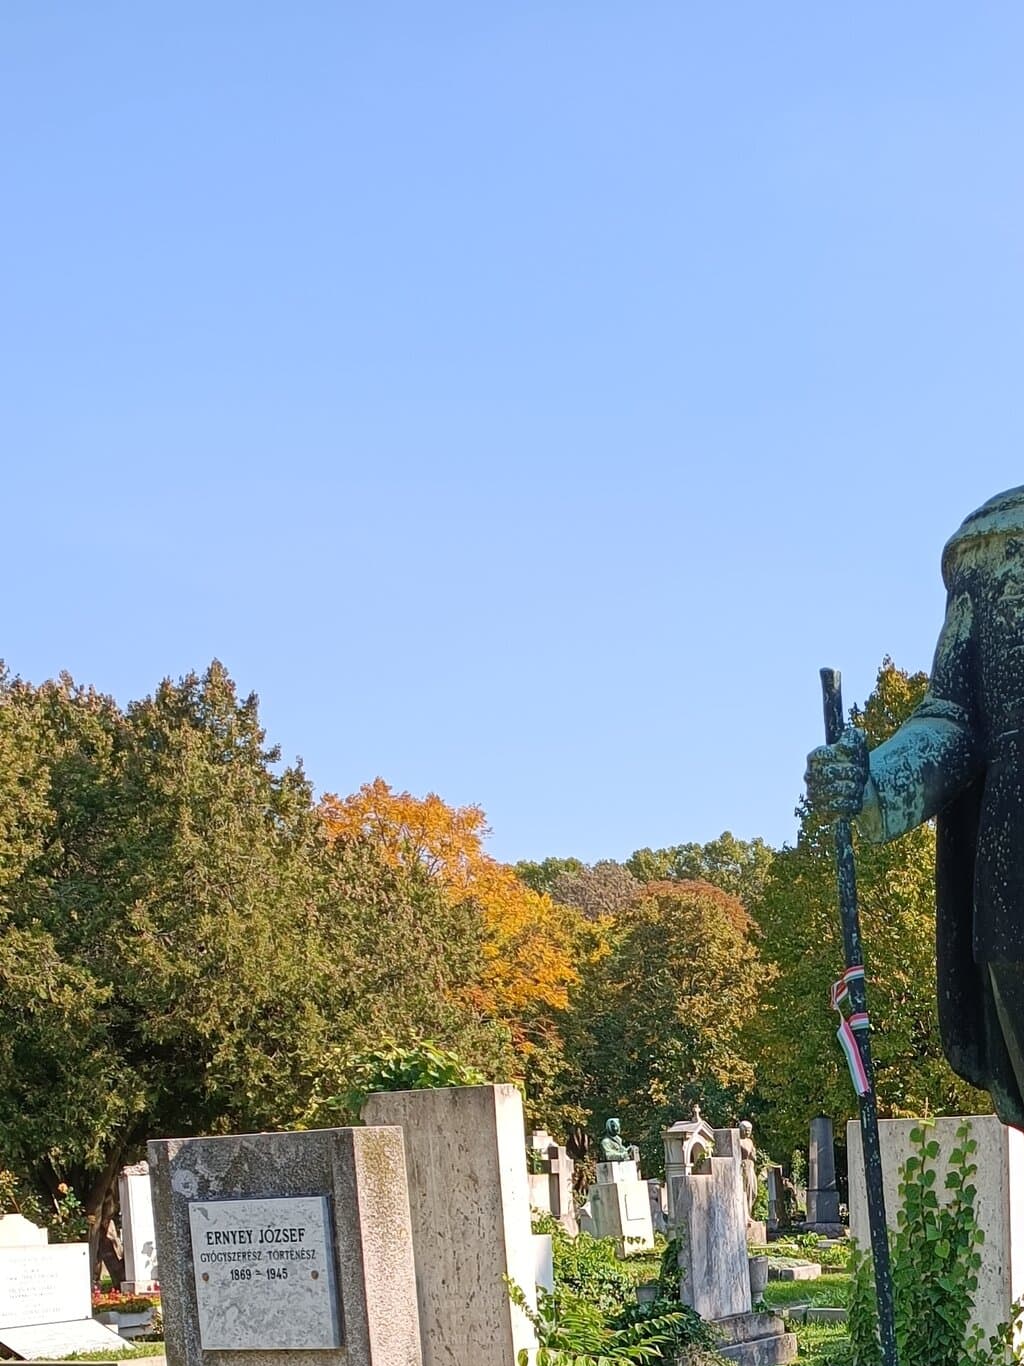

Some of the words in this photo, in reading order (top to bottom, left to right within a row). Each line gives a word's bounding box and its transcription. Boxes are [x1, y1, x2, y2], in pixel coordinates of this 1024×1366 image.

[206, 1230, 253, 1245] ERNYEY
[259, 1225, 306, 1244] JÓZSEF
[230, 1268, 252, 1281] 1869
[266, 1267, 288, 1280] 1945
